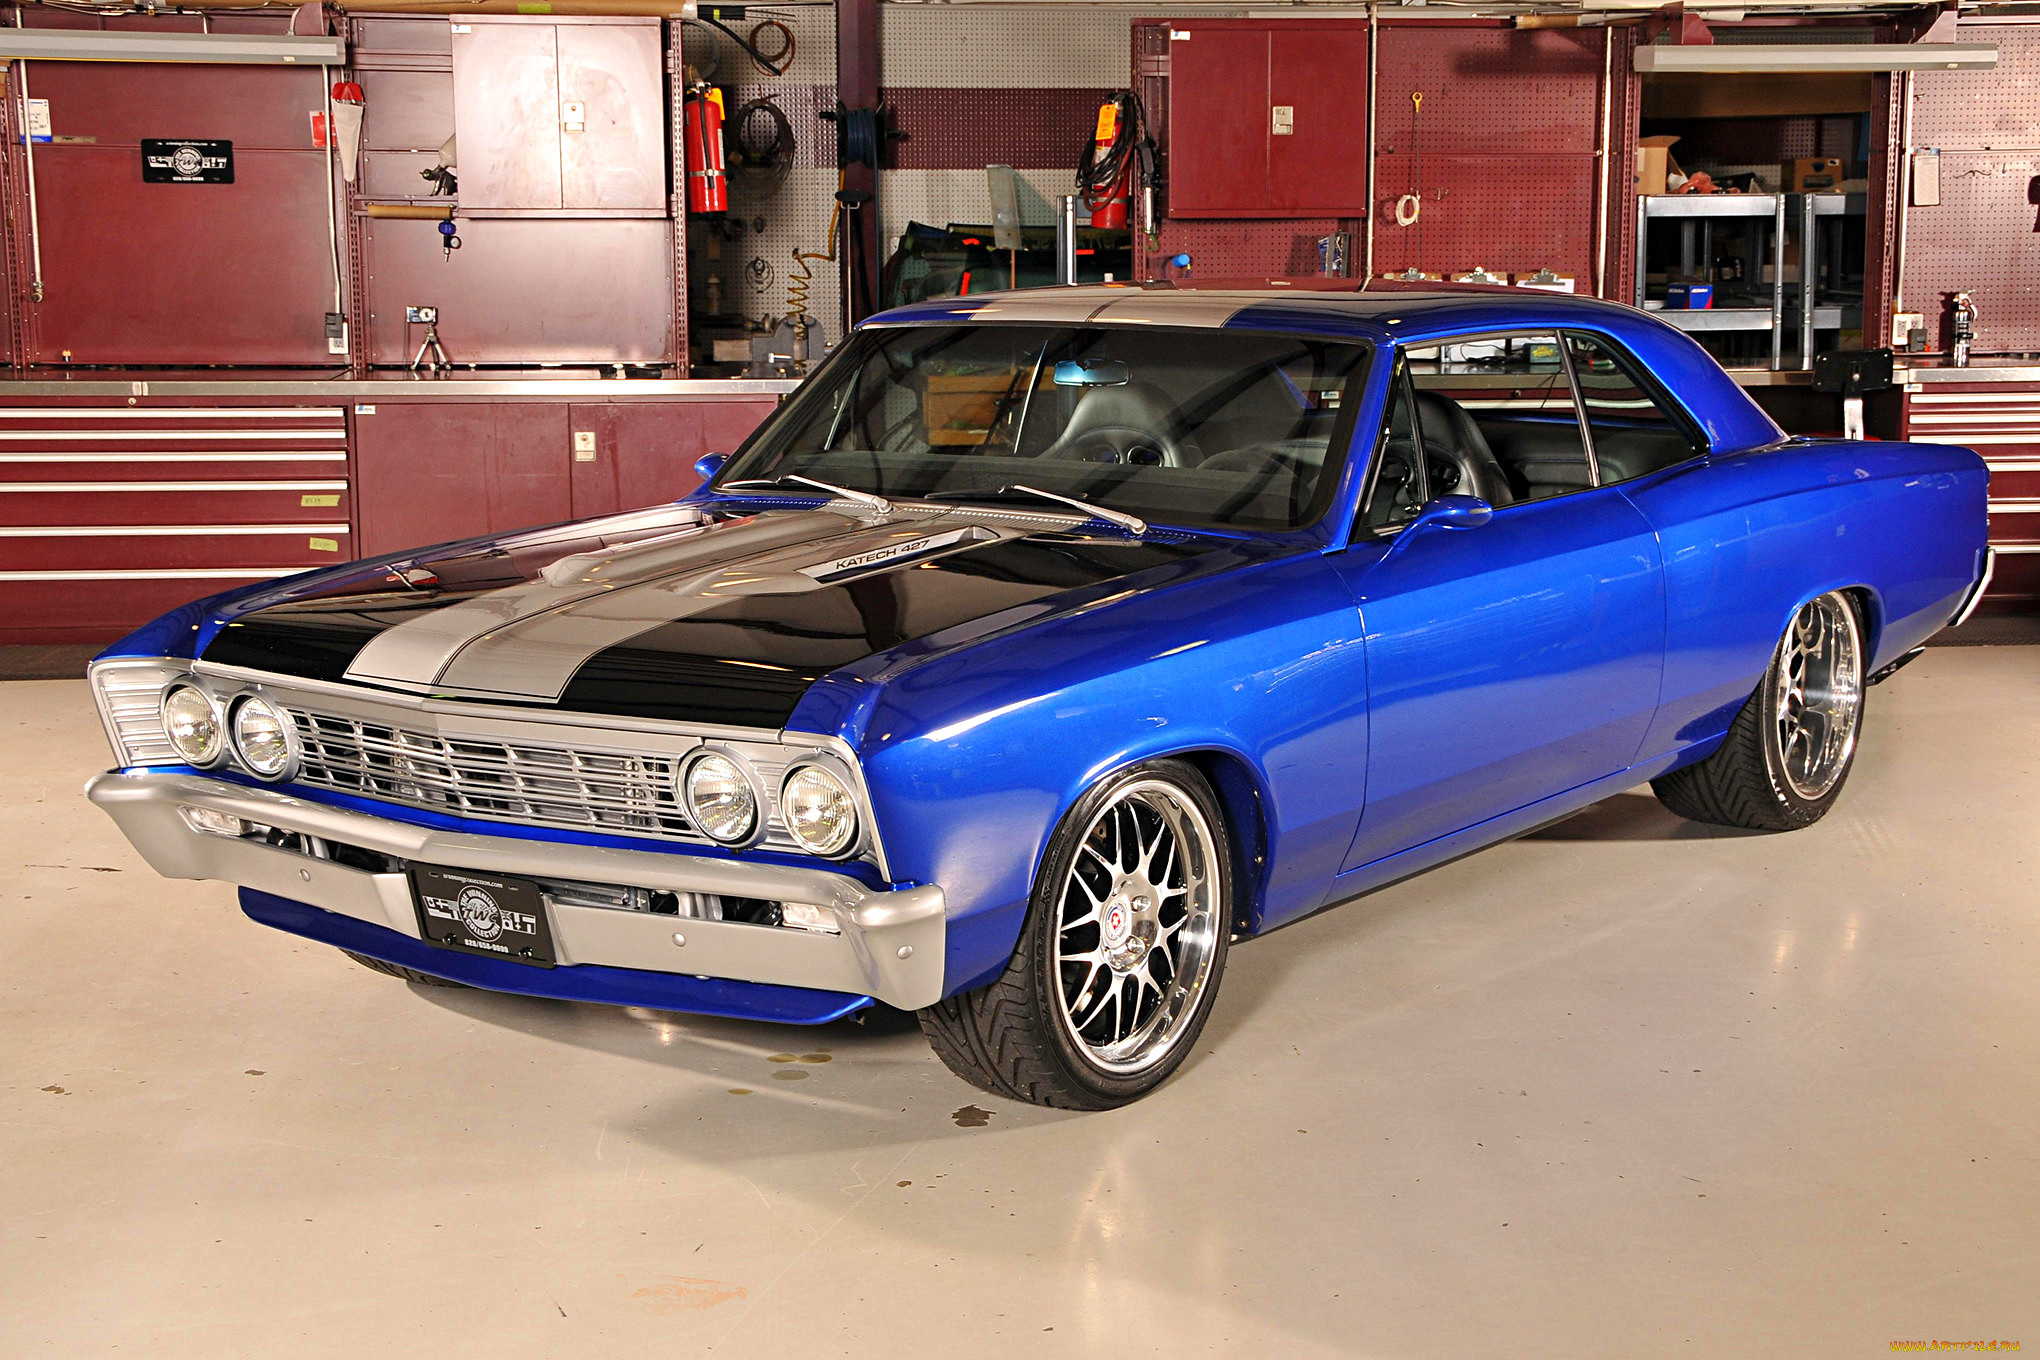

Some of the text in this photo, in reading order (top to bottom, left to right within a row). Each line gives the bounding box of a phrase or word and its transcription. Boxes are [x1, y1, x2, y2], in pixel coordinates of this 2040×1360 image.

[835, 540, 930, 570] KATECH 427
[462, 907, 499, 922] TWC
[465, 918, 501, 938] COLLECTION
